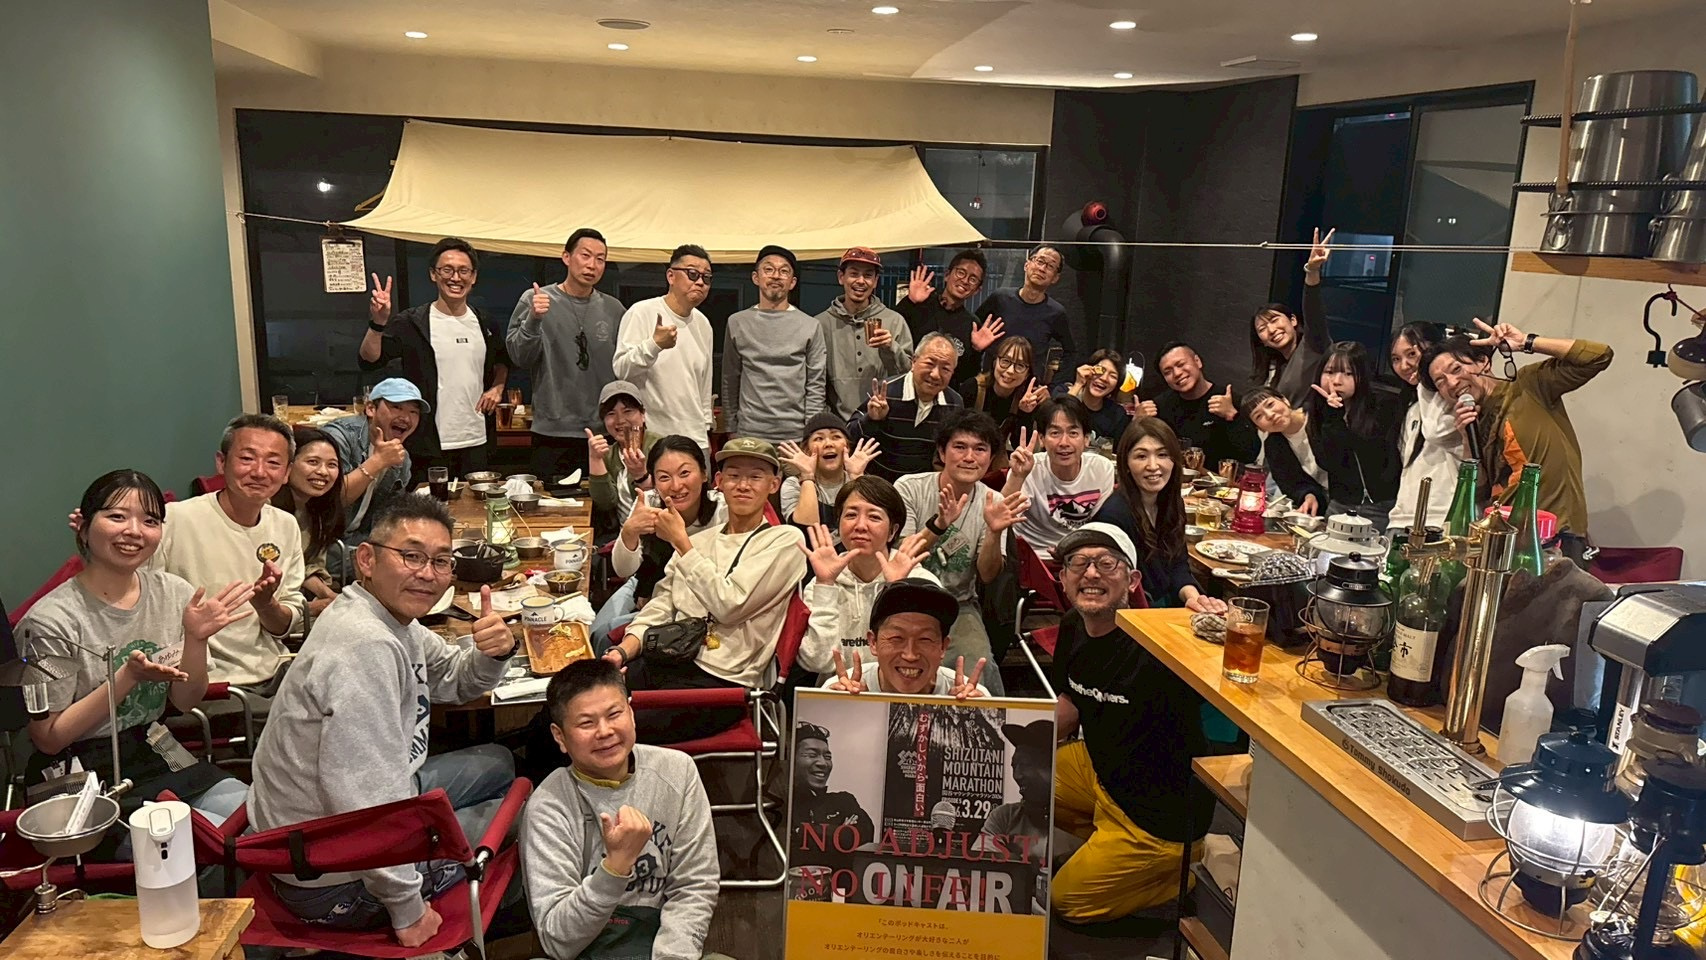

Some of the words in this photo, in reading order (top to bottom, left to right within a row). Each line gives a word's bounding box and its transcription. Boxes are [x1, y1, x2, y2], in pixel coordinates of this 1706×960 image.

[1614, 708, 1625, 740] STANLEY
[943, 761, 1004, 779] MOUNTAIN
[944, 747, 1004, 764] SHIZUTANI
[1349, 744, 1376, 771] Tommy
[942, 776, 1003, 793] MARATHON
[800, 822, 860, 854] NO
[874, 827, 1047, 867] ADJUST,
[800, 867, 858, 898] NO
[862, 861, 924, 906] ON
[937, 868, 1013, 914] AIR
